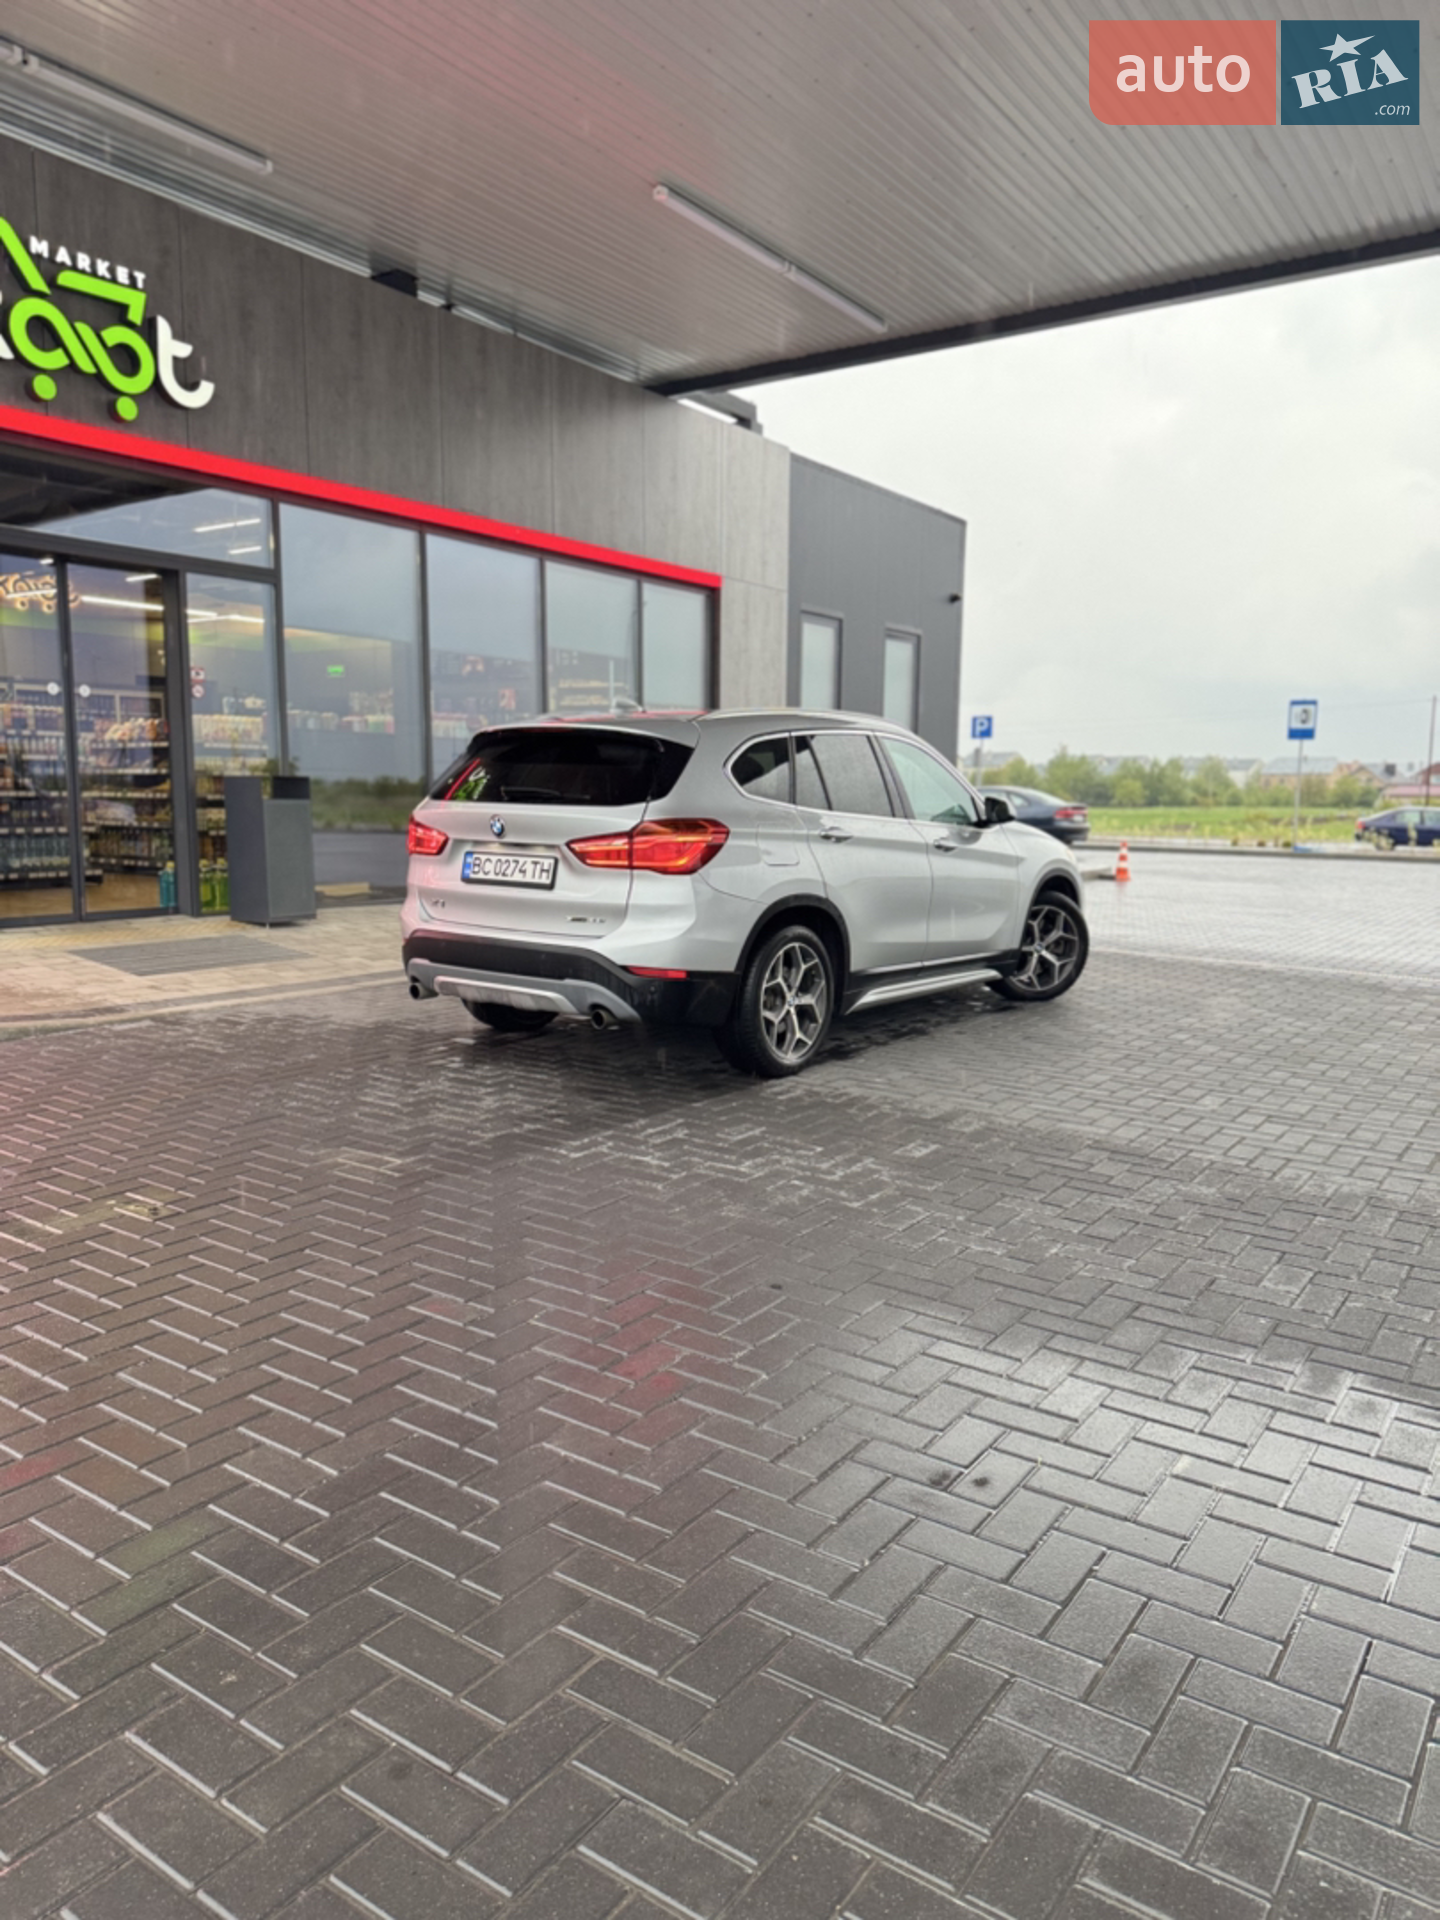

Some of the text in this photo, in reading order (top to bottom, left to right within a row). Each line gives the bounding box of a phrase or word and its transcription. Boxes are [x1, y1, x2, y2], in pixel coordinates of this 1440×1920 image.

[29, 235, 147, 289] MARKET
[471, 857, 493, 877] BC
[493, 858, 528, 879] 0274
[531, 860, 553, 881] TH
